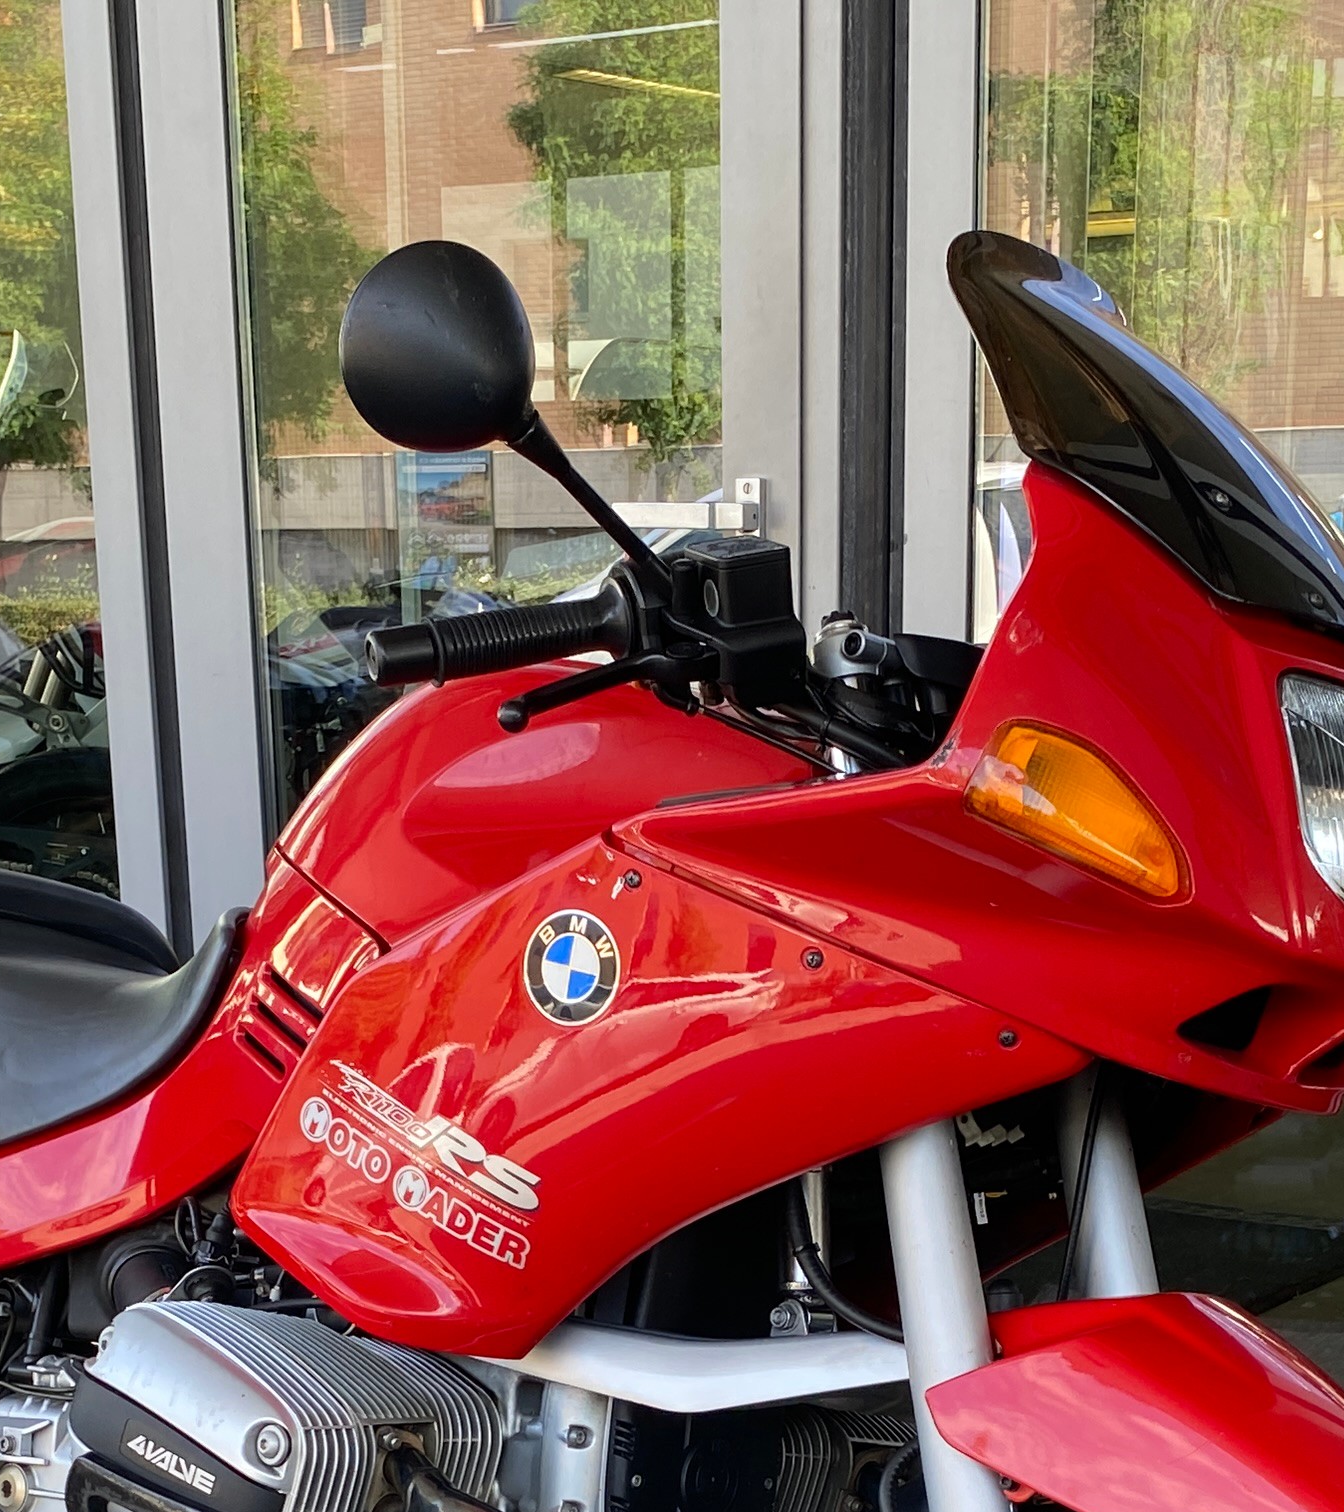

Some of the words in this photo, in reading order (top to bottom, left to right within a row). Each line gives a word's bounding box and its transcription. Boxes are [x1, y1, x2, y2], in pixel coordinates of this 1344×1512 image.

[537, 915, 614, 959] BMW
[299, 1096, 392, 1184] MOTO
[392, 1164, 532, 1271] MADER
[434, 1168, 532, 1228] MANAGEMENT
